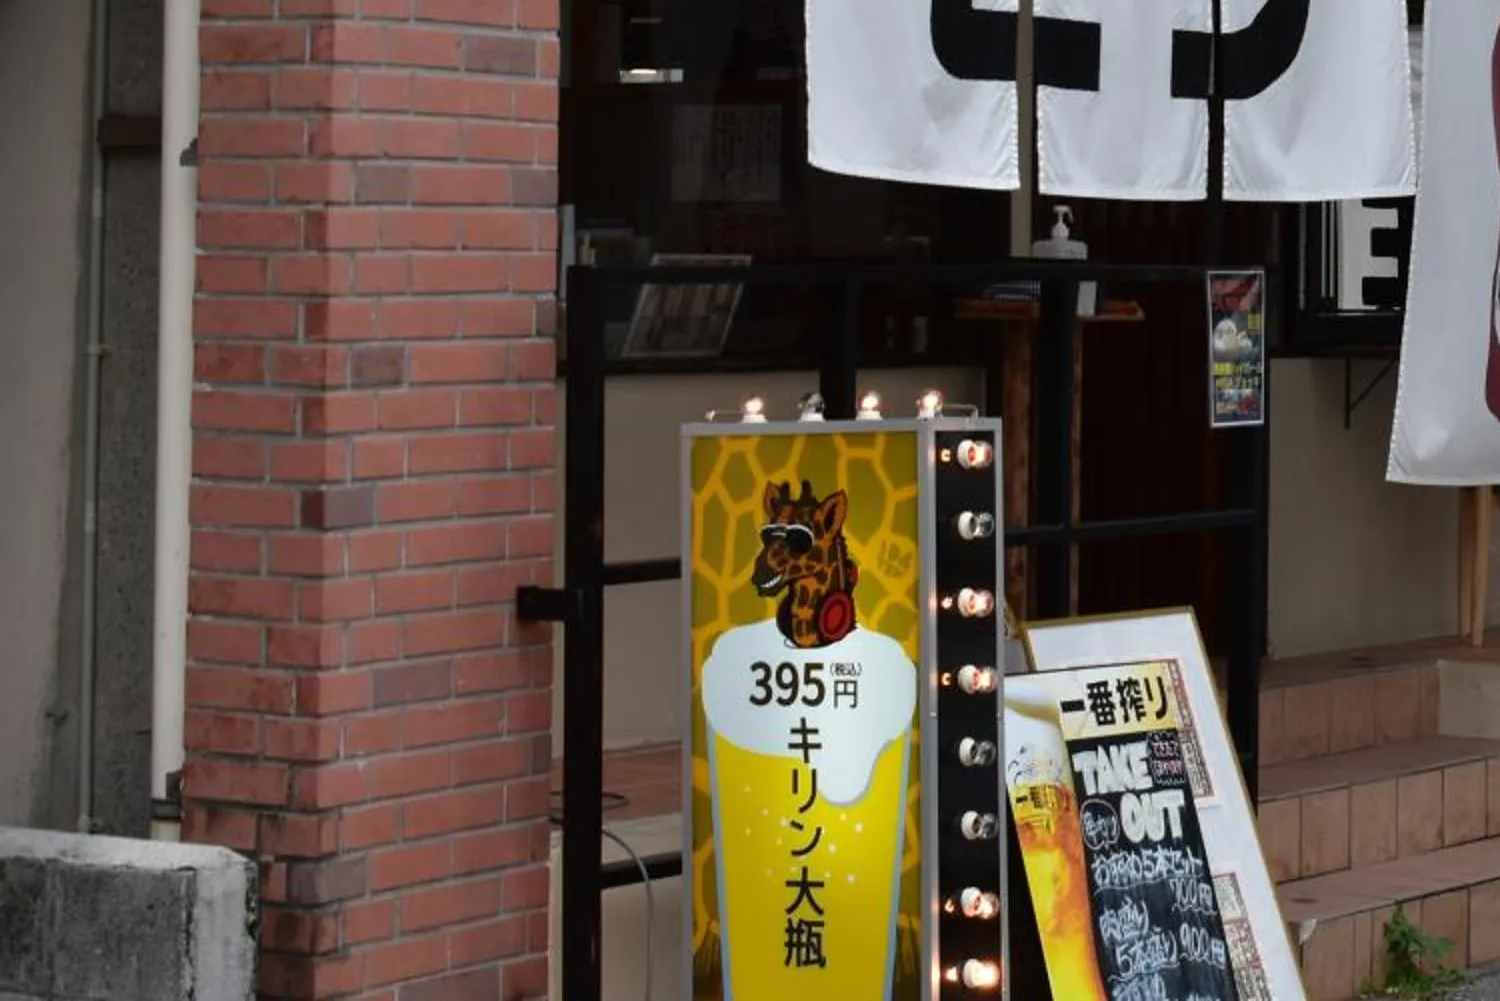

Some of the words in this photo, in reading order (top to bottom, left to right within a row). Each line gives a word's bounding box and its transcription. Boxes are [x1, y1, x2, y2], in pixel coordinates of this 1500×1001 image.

[1060, 675, 1168, 727] 一番搾り
[1071, 740, 1153, 797] TAKE
[783, 715, 828, 971] キリン大瓶
[1119, 789, 1187, 844] OUT
